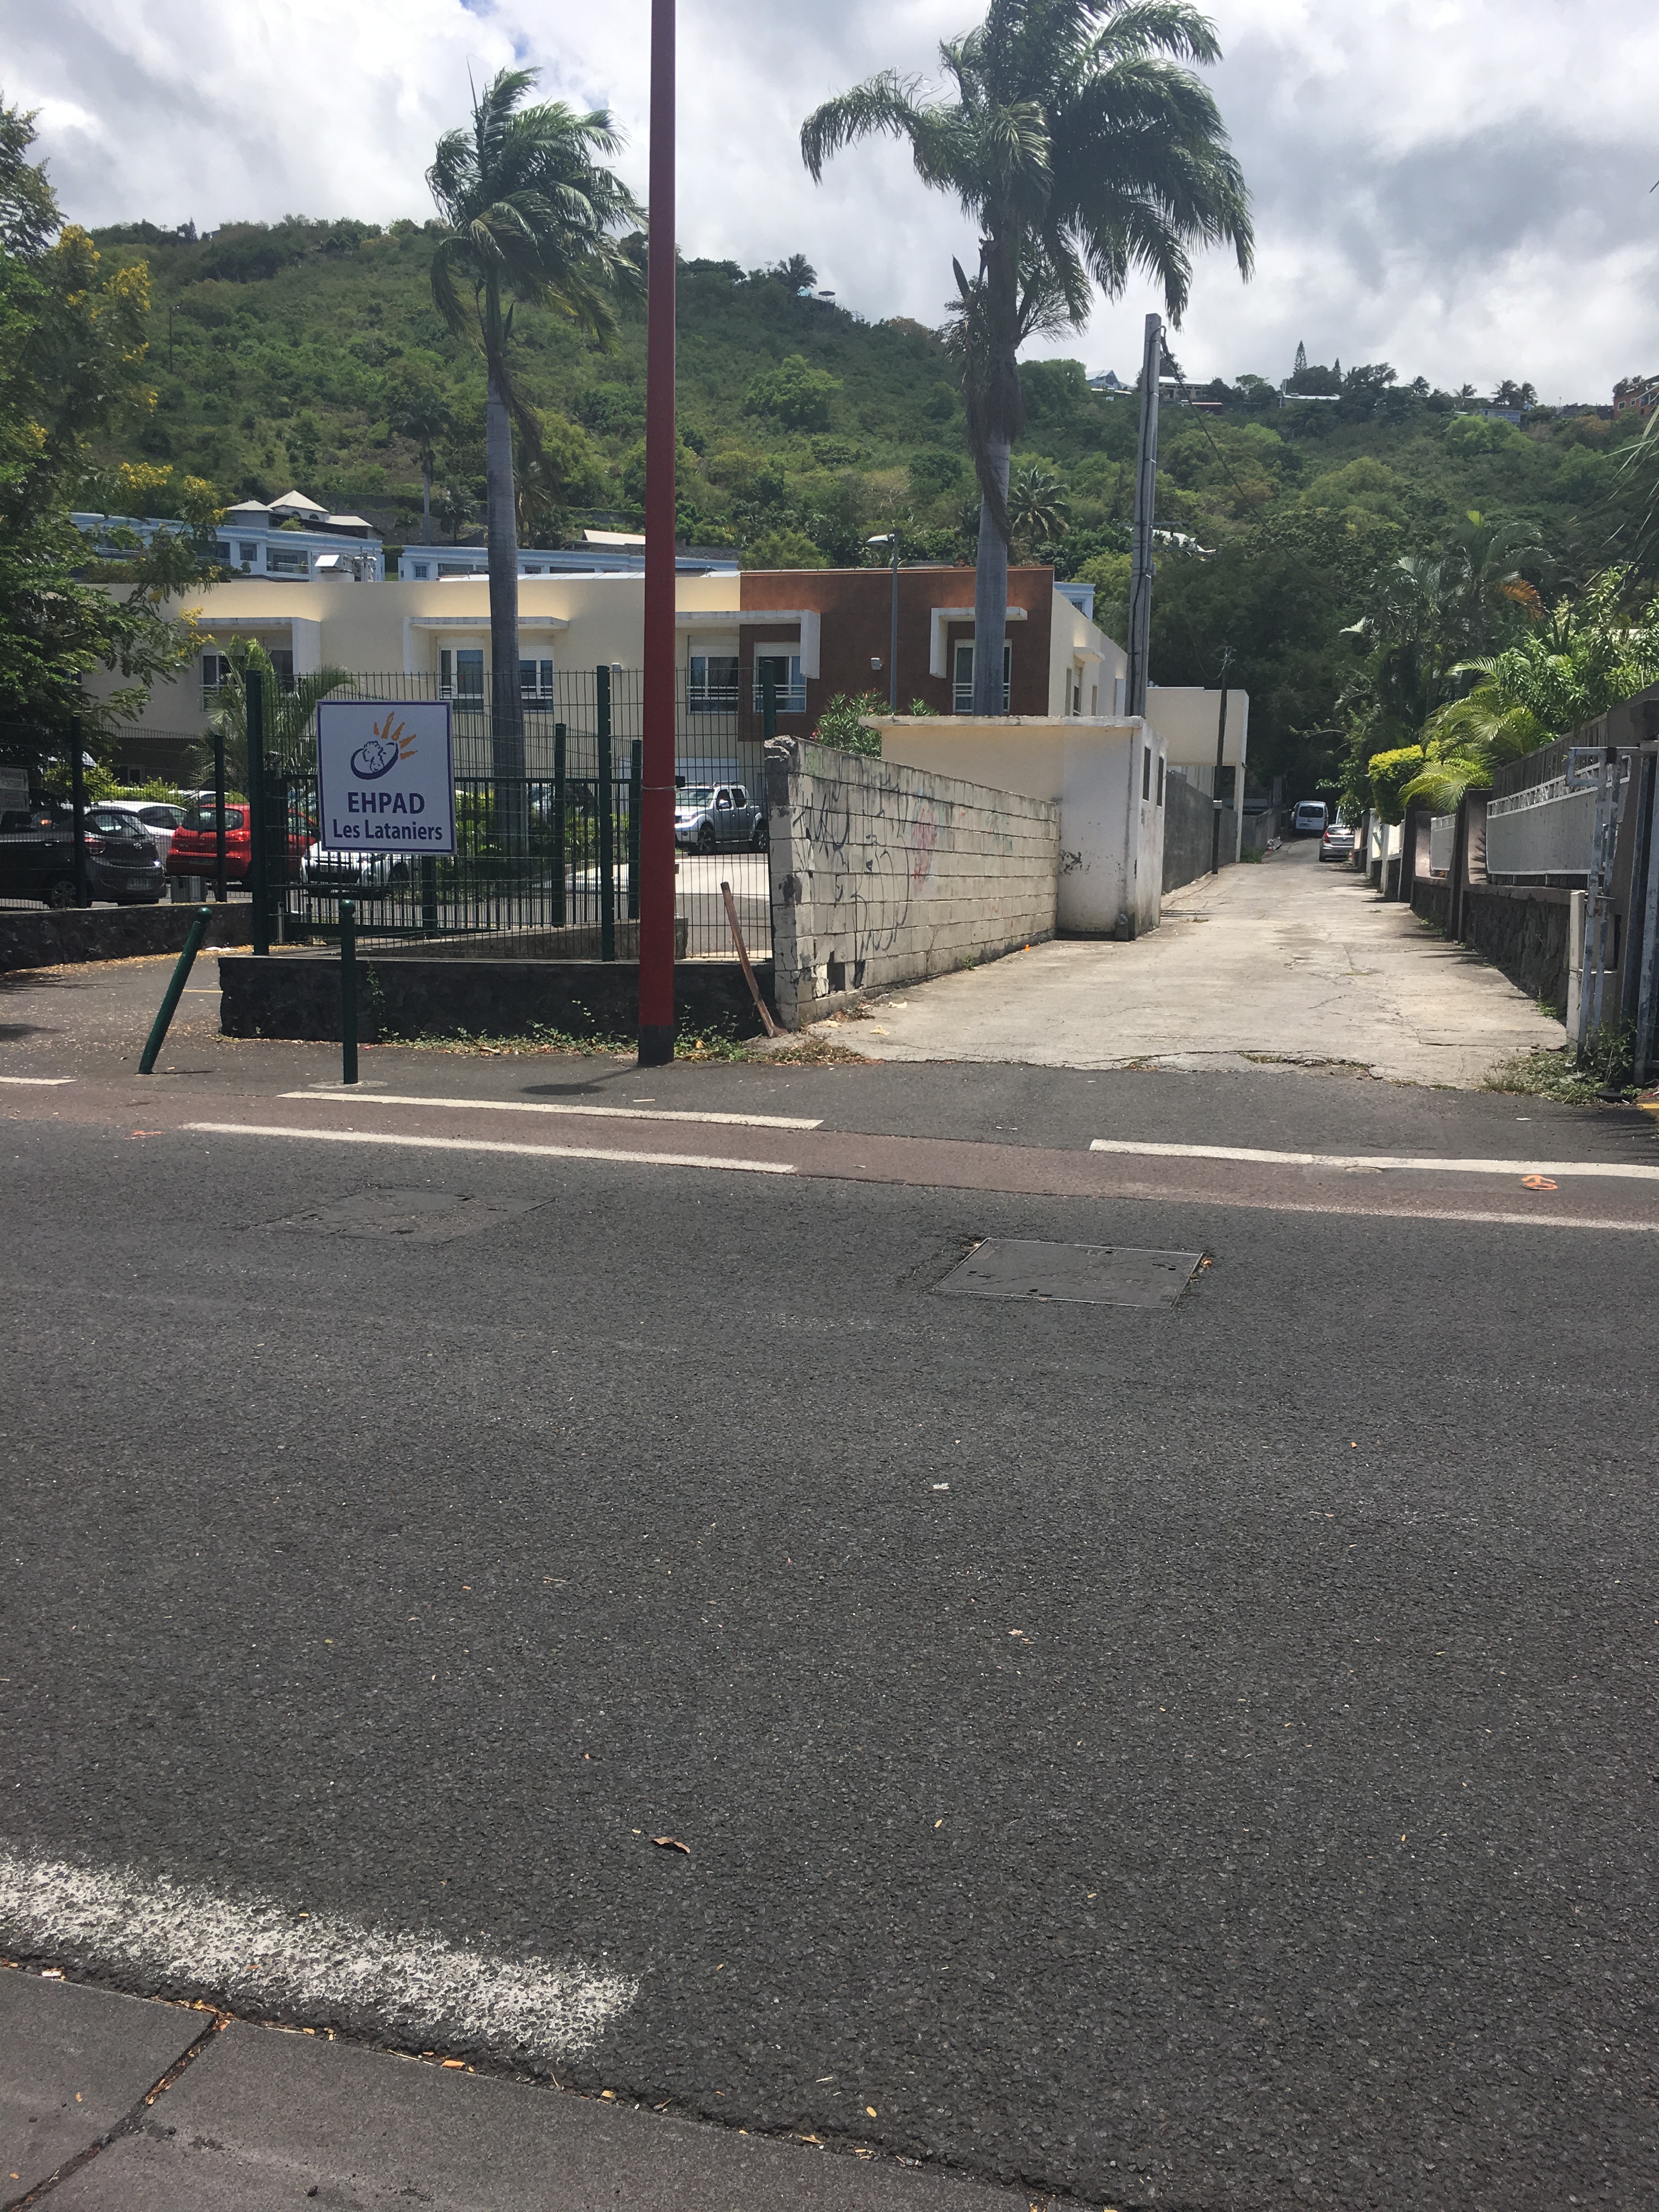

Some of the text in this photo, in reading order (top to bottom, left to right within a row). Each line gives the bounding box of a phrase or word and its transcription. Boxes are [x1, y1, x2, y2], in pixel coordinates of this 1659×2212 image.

[347, 792, 425, 814] EHPAD
[333, 819, 443, 840] Les Lataniers
